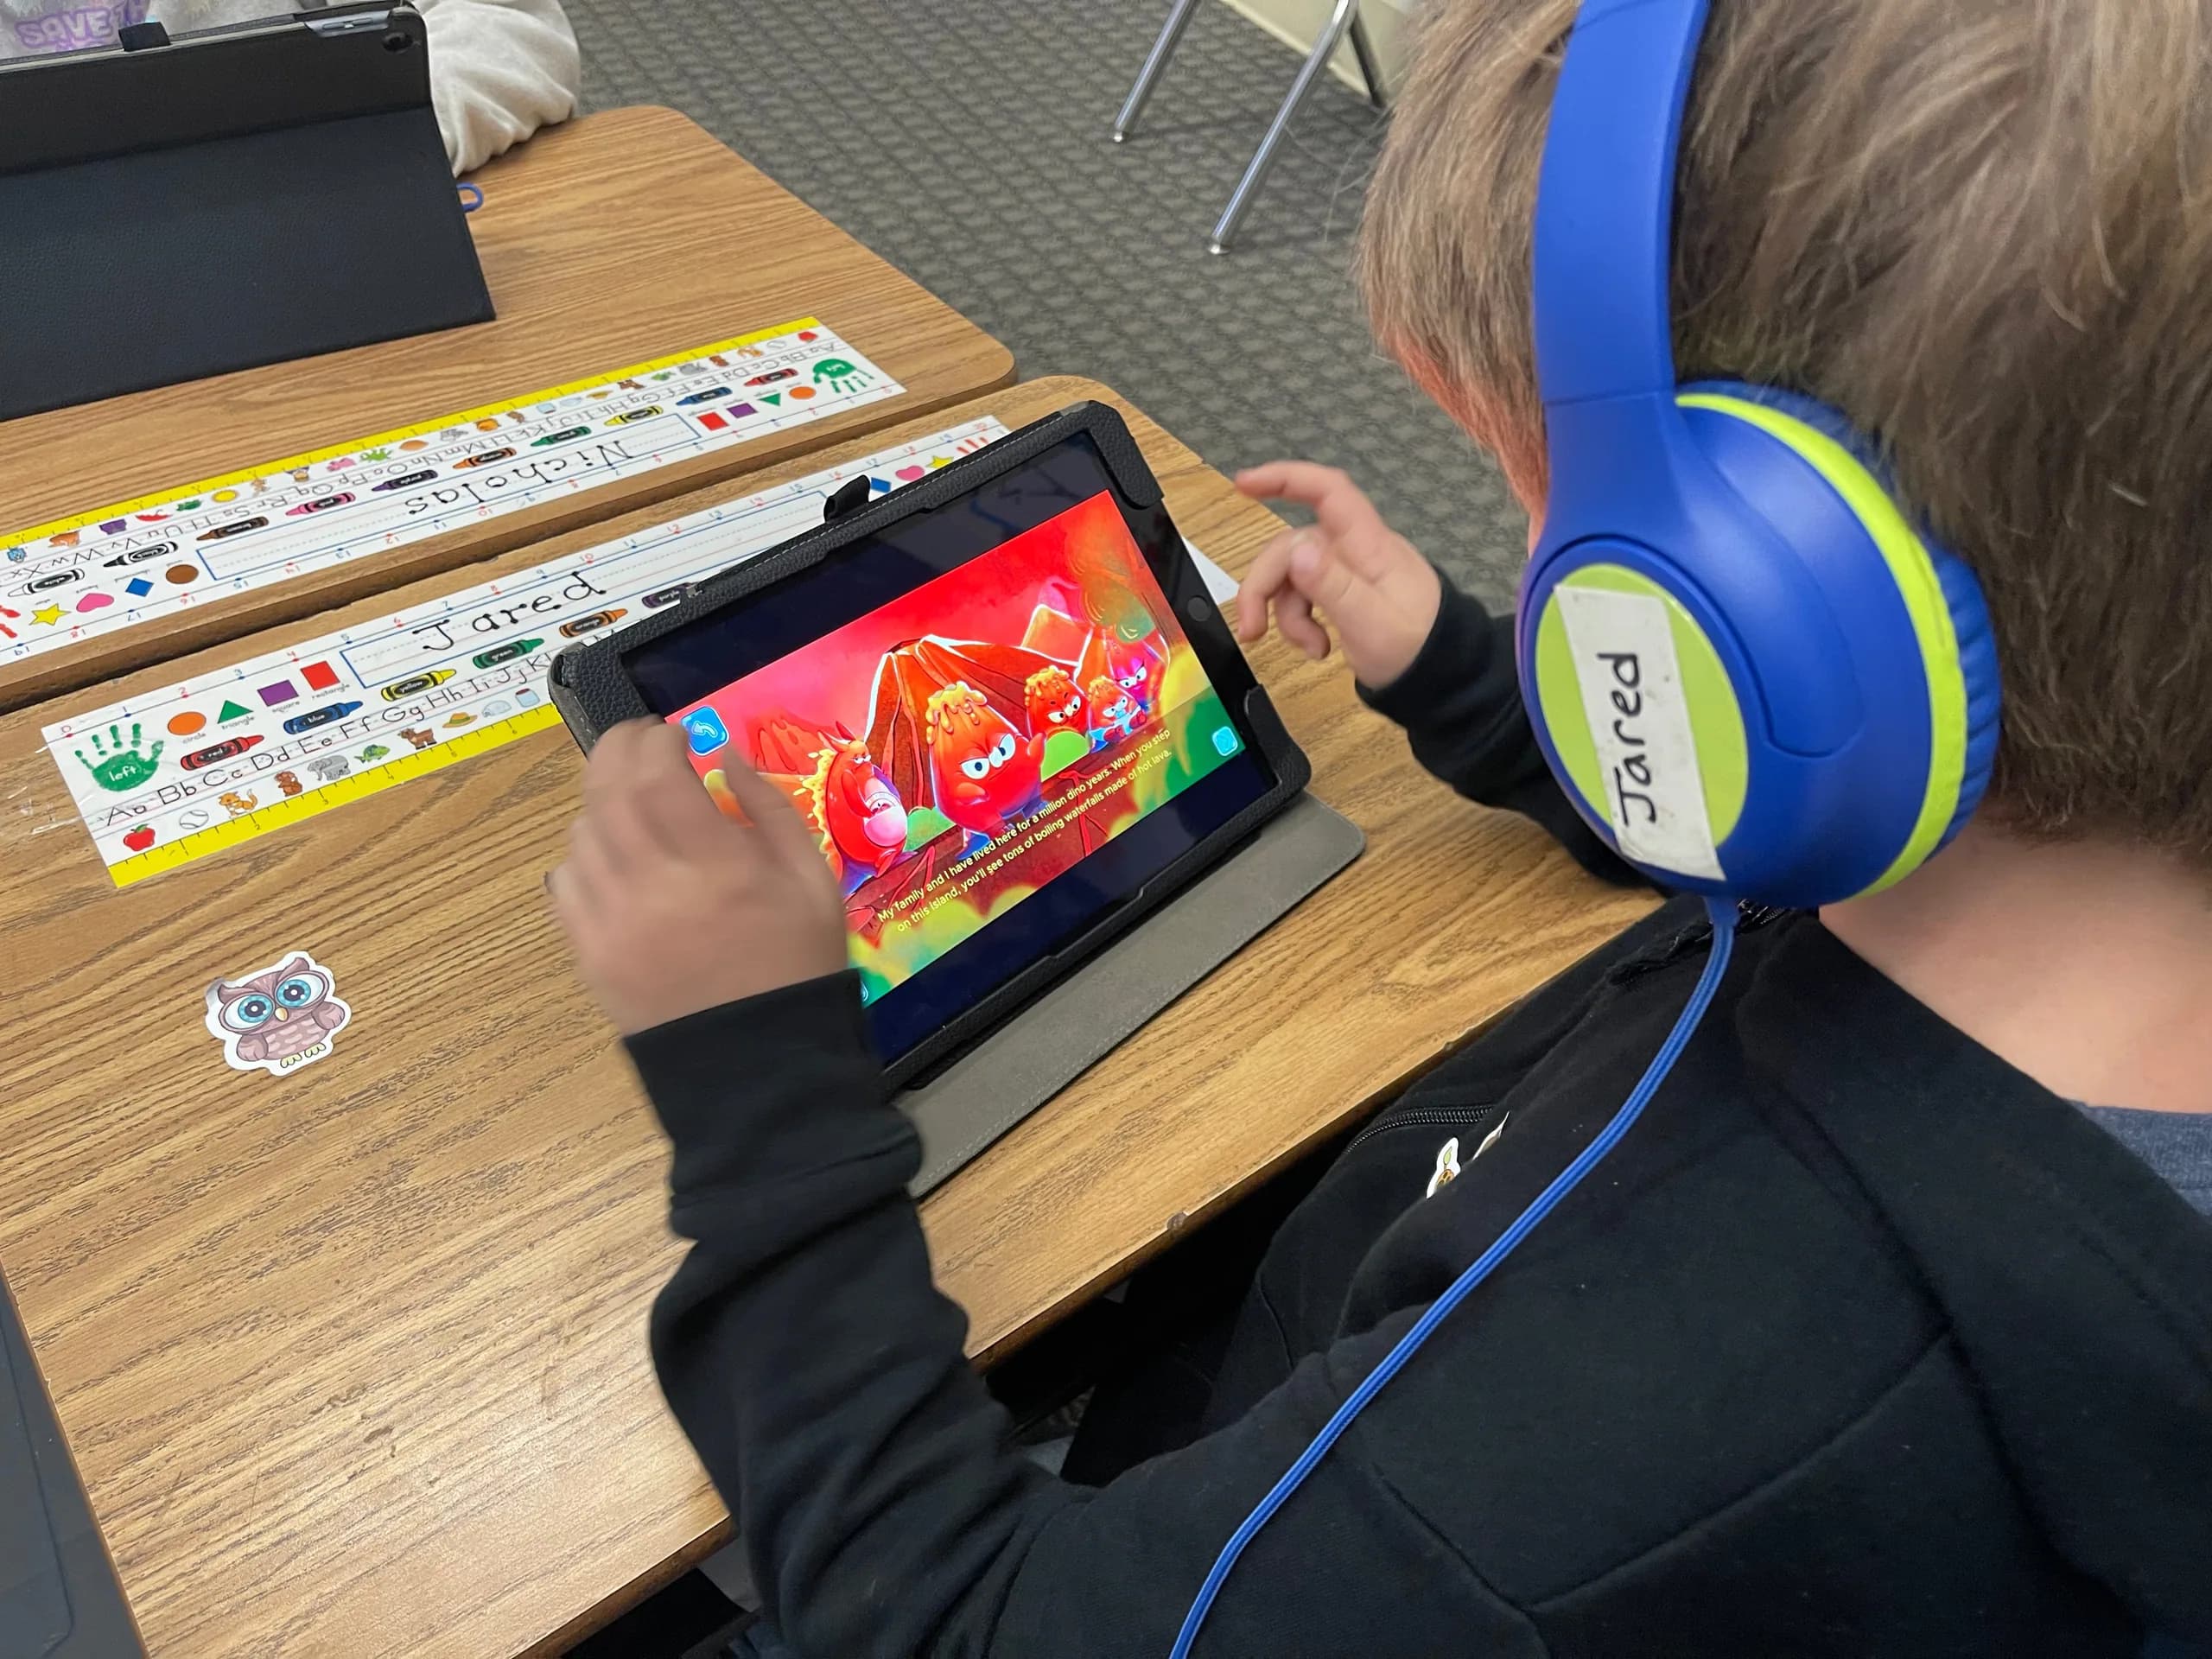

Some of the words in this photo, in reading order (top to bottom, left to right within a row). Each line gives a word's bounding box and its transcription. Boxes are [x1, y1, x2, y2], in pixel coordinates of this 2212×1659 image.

[15, 8, 113, 48] SAVE
[810, 343, 835, 354] Aa
[780, 352, 806, 362] Bb
[752, 359, 779, 369] Cc
[722, 367, 747, 378] Dd
[373, 463, 407, 477] Oo
[339, 473, 368, 486] Pp
[405, 442, 633, 515] Nicholas
[257, 495, 287, 510] Rr
[223, 505, 250, 517] Ss
[579, 552, 594, 562] 10
[623, 538, 637, 547] 11
[666, 524, 681, 532] 12
[709, 510, 723, 518] 13
[790, 483, 803, 492] 15
[148, 525, 183, 538] Uu
[111, 538, 141, 550] Vv
[51, 549, 104, 564] Ww
[334, 550, 351, 559] 13
[10, 563, 43, 579] Xx
[286, 565, 301, 574] 14
[180, 596, 196, 605] 16
[127, 612, 142, 621] 17
[411, 570, 607, 651] Jared
[70, 629, 86, 639] 18
[14, 645, 29, 656] 19
[398, 679, 423, 695] yellow
[307, 712, 326, 724] blue
[107, 803, 148, 826] Aa
[156, 781, 197, 805] Bb
[203, 768, 244, 787] Cc
[250, 746, 290, 771] Dd
[297, 735, 333, 754] Ee
[339, 715, 372, 739] Ff
[382, 705, 425, 722] Gg
[425, 689, 464, 709] Hh
[468, 677, 490, 693] Ii
[497, 665, 528, 684] Jj
[1596, 652, 1657, 827] Jared
[207, 747, 223, 757] red
[108, 764, 137, 783] left
[877, 908, 894, 923] My
[895, 888, 925, 912] family
[926, 874, 945, 892] and
[944, 871, 950, 880] I
[950, 857, 974, 877] have
[973, 842, 996, 861] lived
[995, 830, 1018, 847] here
[1017, 819, 1031, 832] for
[1039, 797, 1068, 819] million
[1067, 784, 1086, 800] dino
[1085, 769, 1113, 790] years.
[1111, 751, 1137, 771] When
[1137, 741, 1153, 758] you
[1153, 728, 1171, 744] step
[897, 919, 912, 932] on
[911, 907, 930, 923] this
[931, 887, 961, 907] island,
[960, 868, 987, 892] you'll
[988, 858, 1004, 874] see
[1002, 845, 1025, 862] tons
[1025, 836, 1035, 849] of
[1034, 818, 1065, 842] boiling
[1065, 792, 1104, 823] waterfalls
[1104, 777, 1128, 796] made
[1128, 767, 1137, 780] of
[1137, 760, 1153, 774] hot
[1153, 750, 1173, 766] lava.
